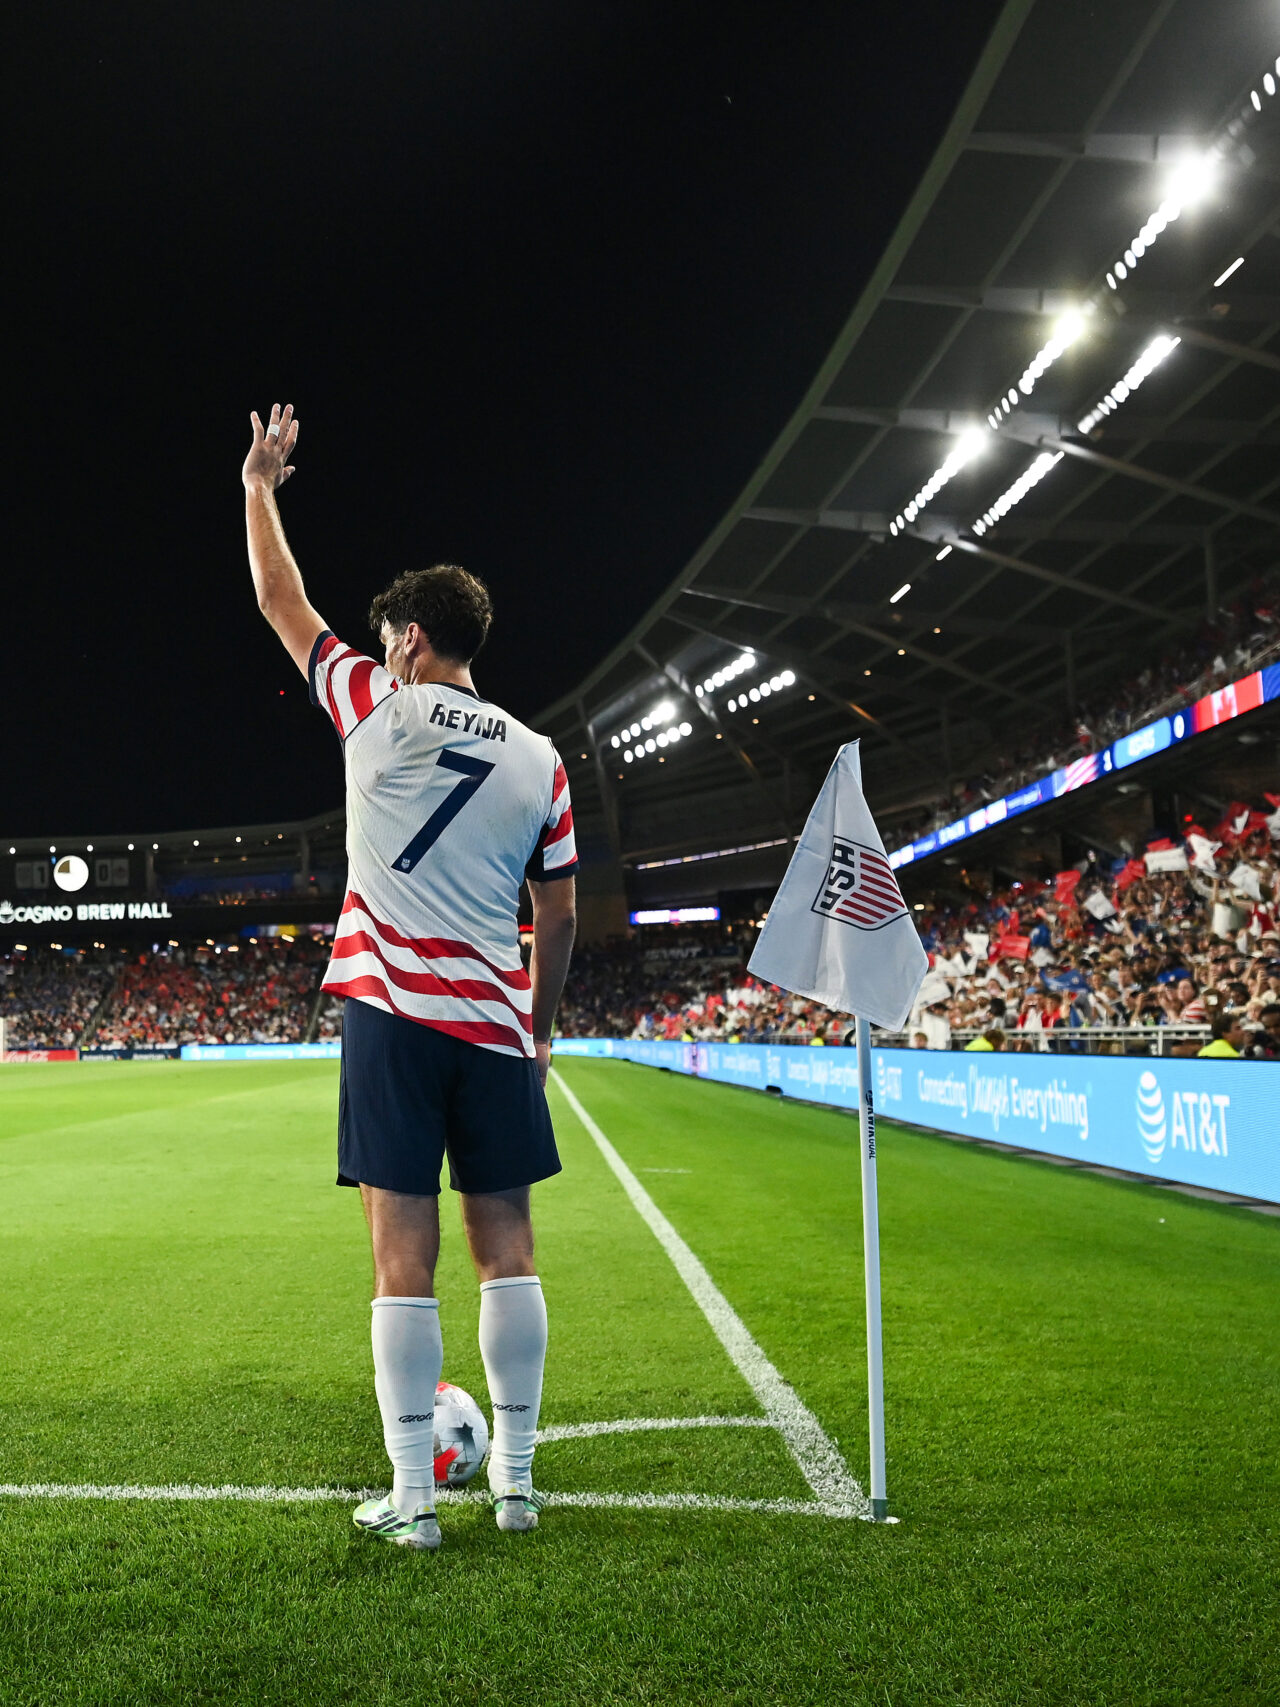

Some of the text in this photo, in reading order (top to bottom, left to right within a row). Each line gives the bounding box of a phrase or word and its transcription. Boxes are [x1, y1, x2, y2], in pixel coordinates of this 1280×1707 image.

[429, 703, 507, 742] REYNA
[1174, 715, 1185, 738] 0
[391, 748, 496, 874] 7
[820, 842, 855, 911] USA
[14, 905, 73, 924] CASINO
[77, 903, 125, 921] BREW
[128, 902, 172, 919] HALL
[918, 1070, 967, 1118] Connecting
[1011, 1077, 1089, 1140] Everything
[1172, 1091, 1230, 1157] AT&T
